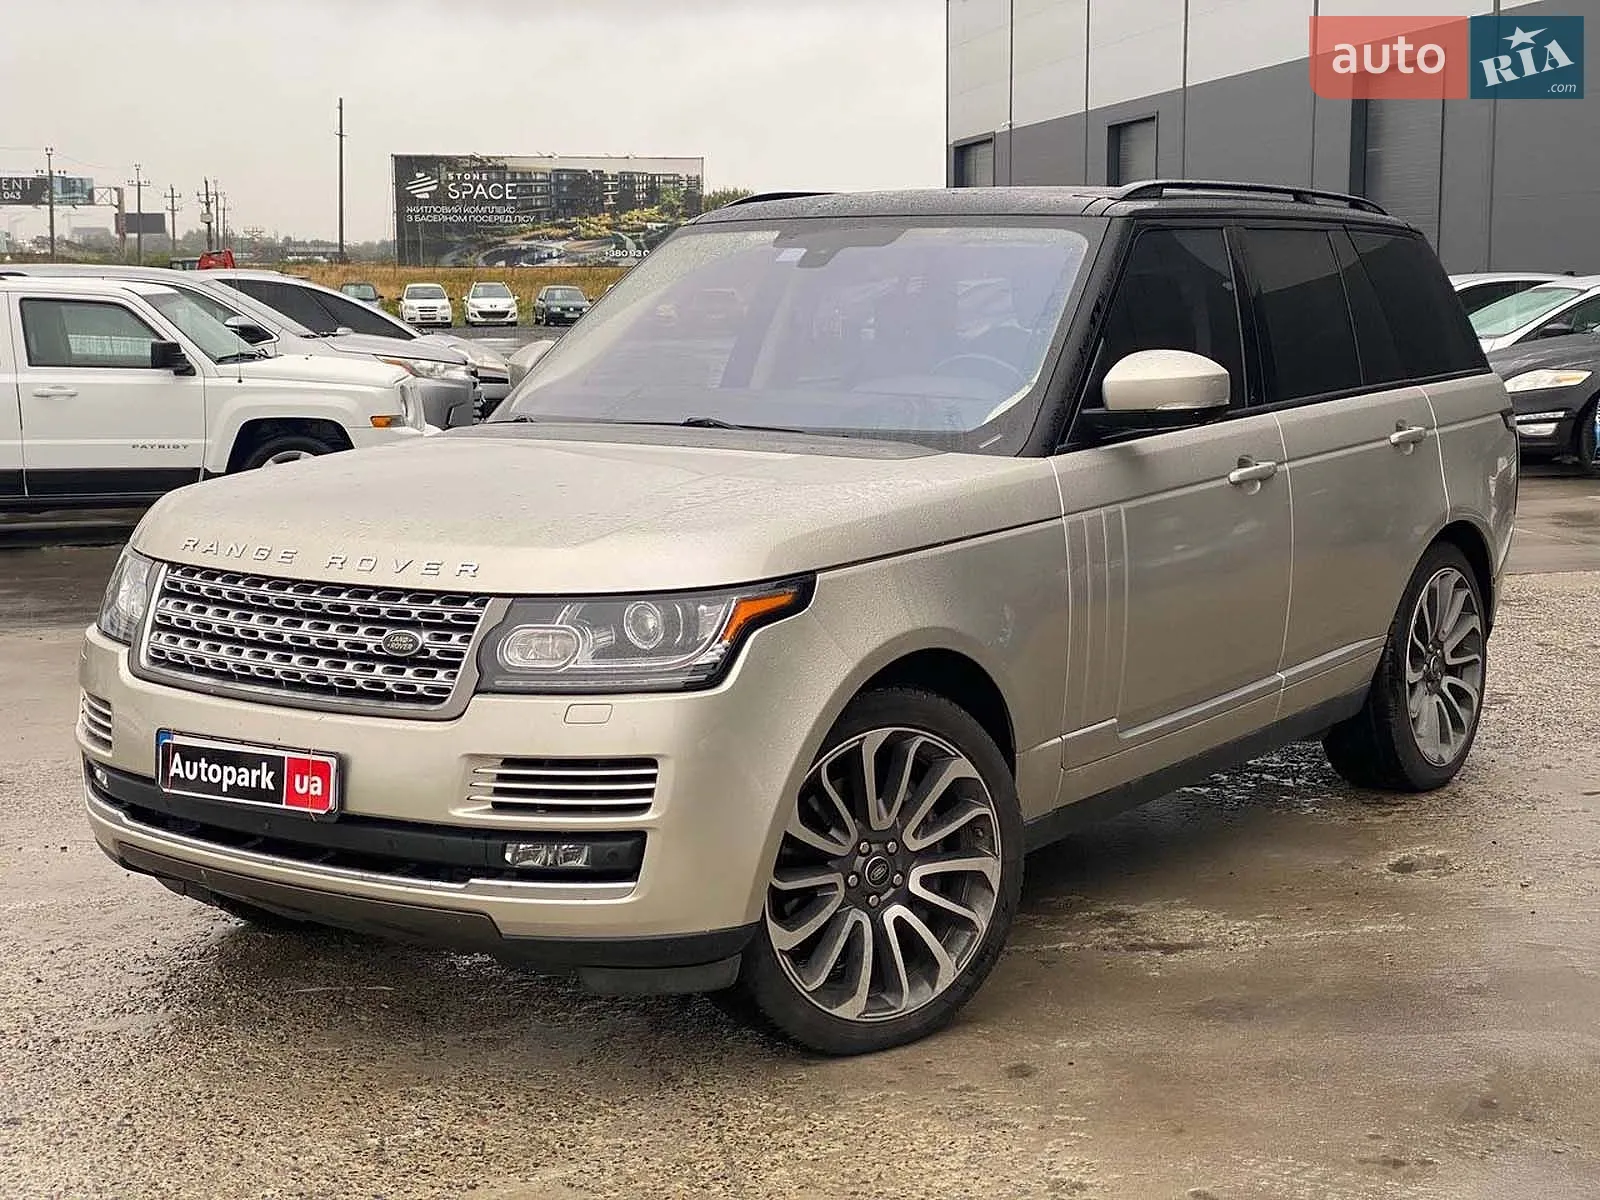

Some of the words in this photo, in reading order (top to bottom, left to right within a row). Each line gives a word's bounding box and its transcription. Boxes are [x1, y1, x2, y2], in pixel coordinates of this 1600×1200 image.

[448, 172, 488, 181] STONE
[2, 178, 32, 190] ENT
[448, 183, 517, 200] SPACE
[406, 203, 461, 214] ЖИТЛОВИЙ
[463, 205, 516, 215] КОМПЛЕКС
[414, 213, 467, 223] БАСЕЙНОМ
[468, 214, 513, 224] ПОСЕРЕД
[180, 536, 298, 564] RANGE
[324, 553, 481, 579] ROVER
[169, 751, 276, 793] Autopark
[294, 773, 323, 797] ua
